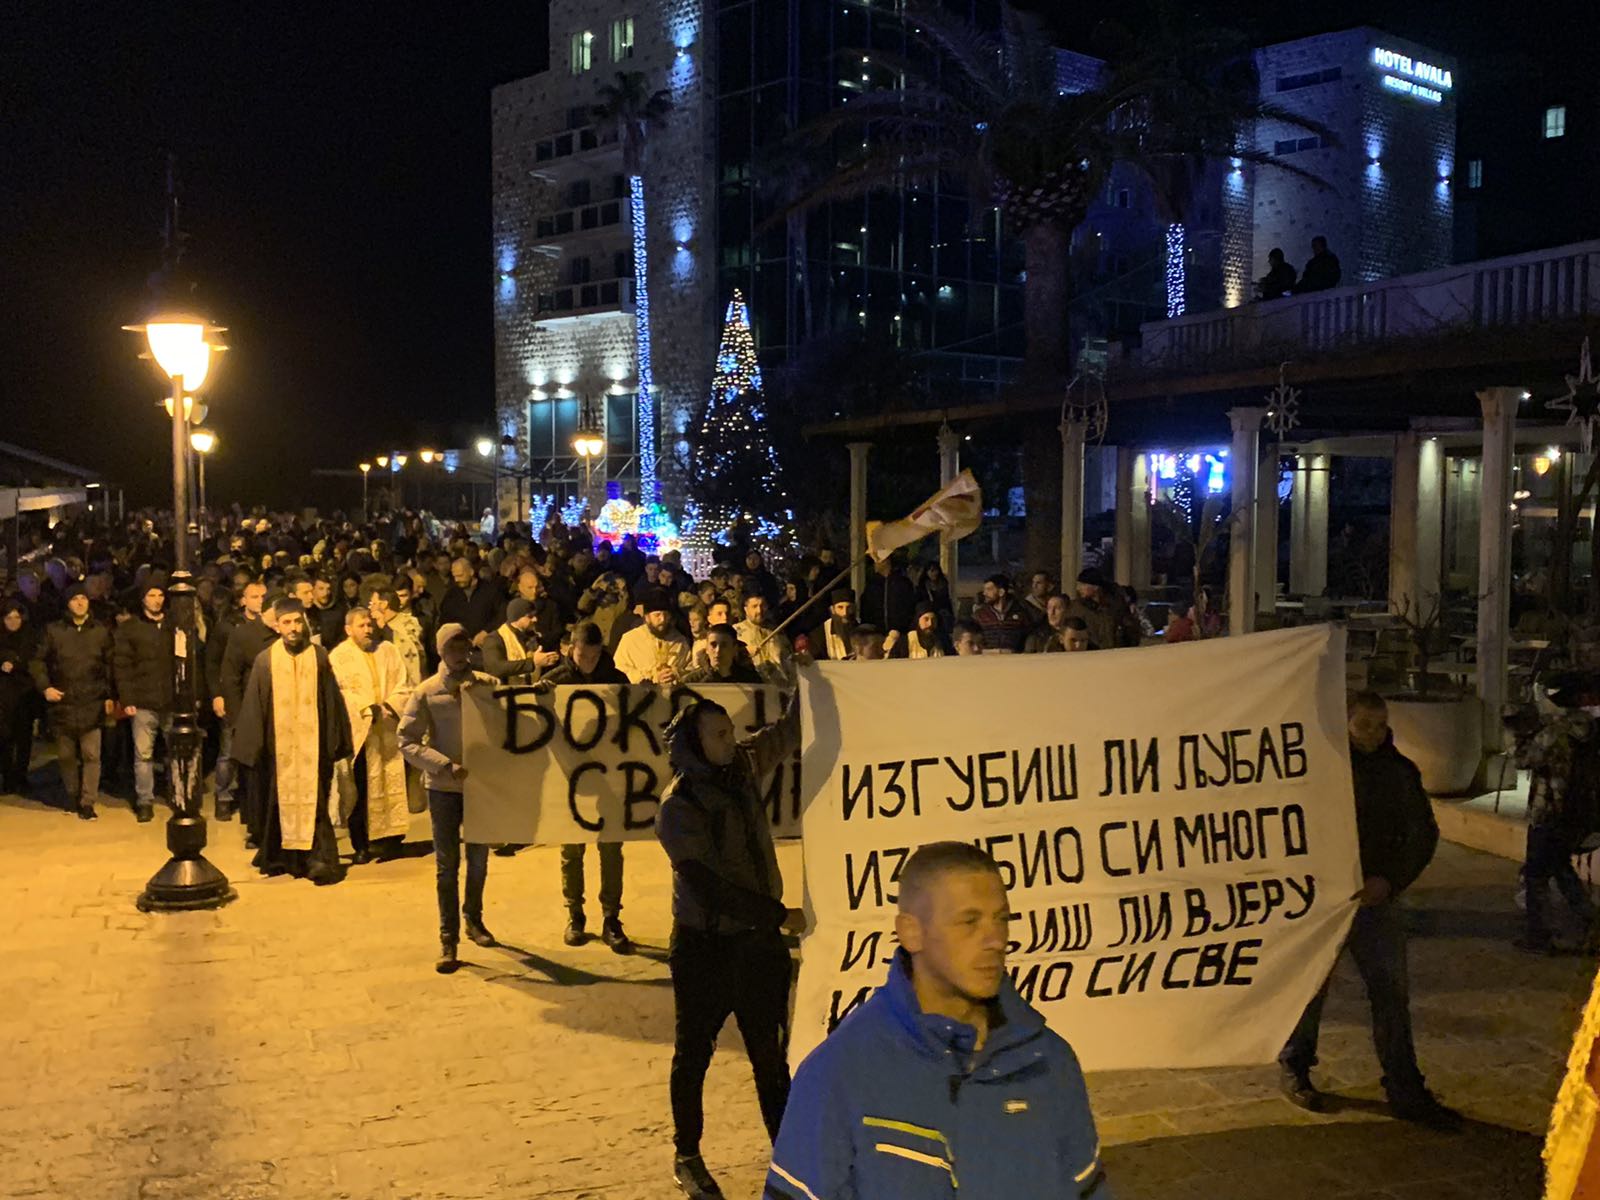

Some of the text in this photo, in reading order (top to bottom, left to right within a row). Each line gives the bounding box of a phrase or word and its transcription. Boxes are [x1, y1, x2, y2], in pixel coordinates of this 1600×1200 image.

[1374, 47, 1452, 88] HOTEL AVALA
[842, 743, 1079, 821] ИЗГУБИШ
[1099, 737, 1159, 797] ЛИ
[1174, 722, 1308, 791] ЉУБАВ
[845, 804, 1309, 910] ИЗБИО СИ МНОГО
[1107, 892, 1172, 948] ЛИ
[1182, 874, 1316, 938] ВЈЕРУ
[1085, 951, 1157, 999] СИ
[1161, 938, 1263, 990] СВЕ
